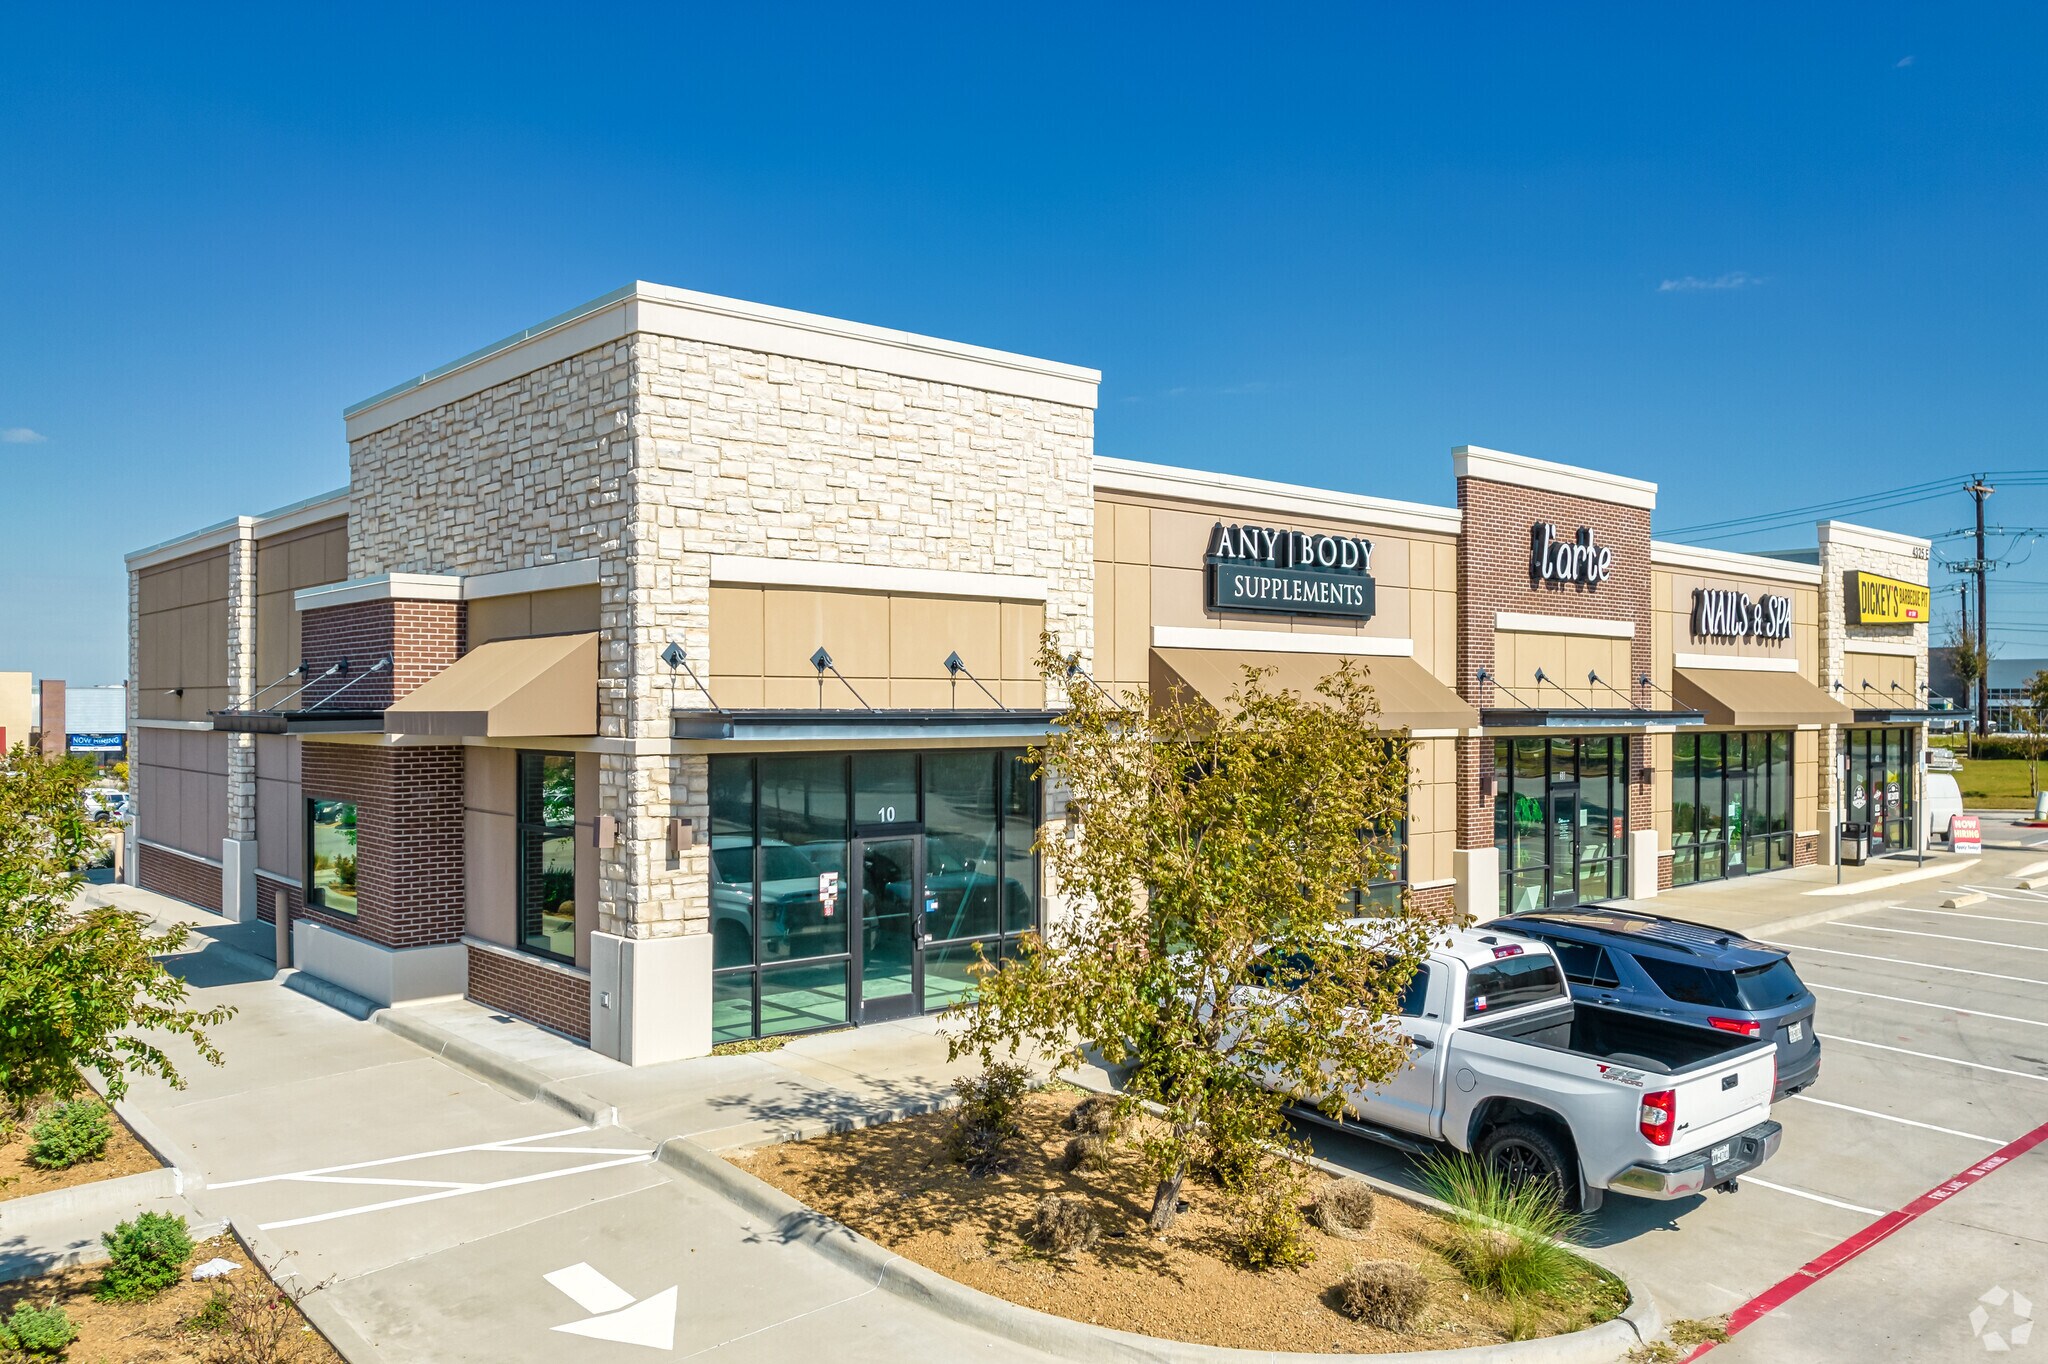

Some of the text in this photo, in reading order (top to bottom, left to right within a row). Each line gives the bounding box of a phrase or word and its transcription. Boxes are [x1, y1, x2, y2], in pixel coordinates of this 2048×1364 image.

[1216, 526, 1375, 570] ANY BODY
[1541, 523, 1611, 581] l'arte
[1234, 574, 1363, 606] SUPPLEMENTS
[1861, 580, 1899, 618] DICKEY'S
[1899, 587, 1921, 607] BARBECUE
[1701, 589, 1792, 639] NAILS & SPA
[73, 736, 119, 744] NOW HIRING
[878, 806, 896, 823] 10
[1954, 820, 1977, 829] NOW
[1954, 829, 1980, 839] HIRING
[1602, 1073, 1644, 1088] OFF-ROAD
[1927, 1156, 2009, 1200] FIRE LANE NO PARKING
